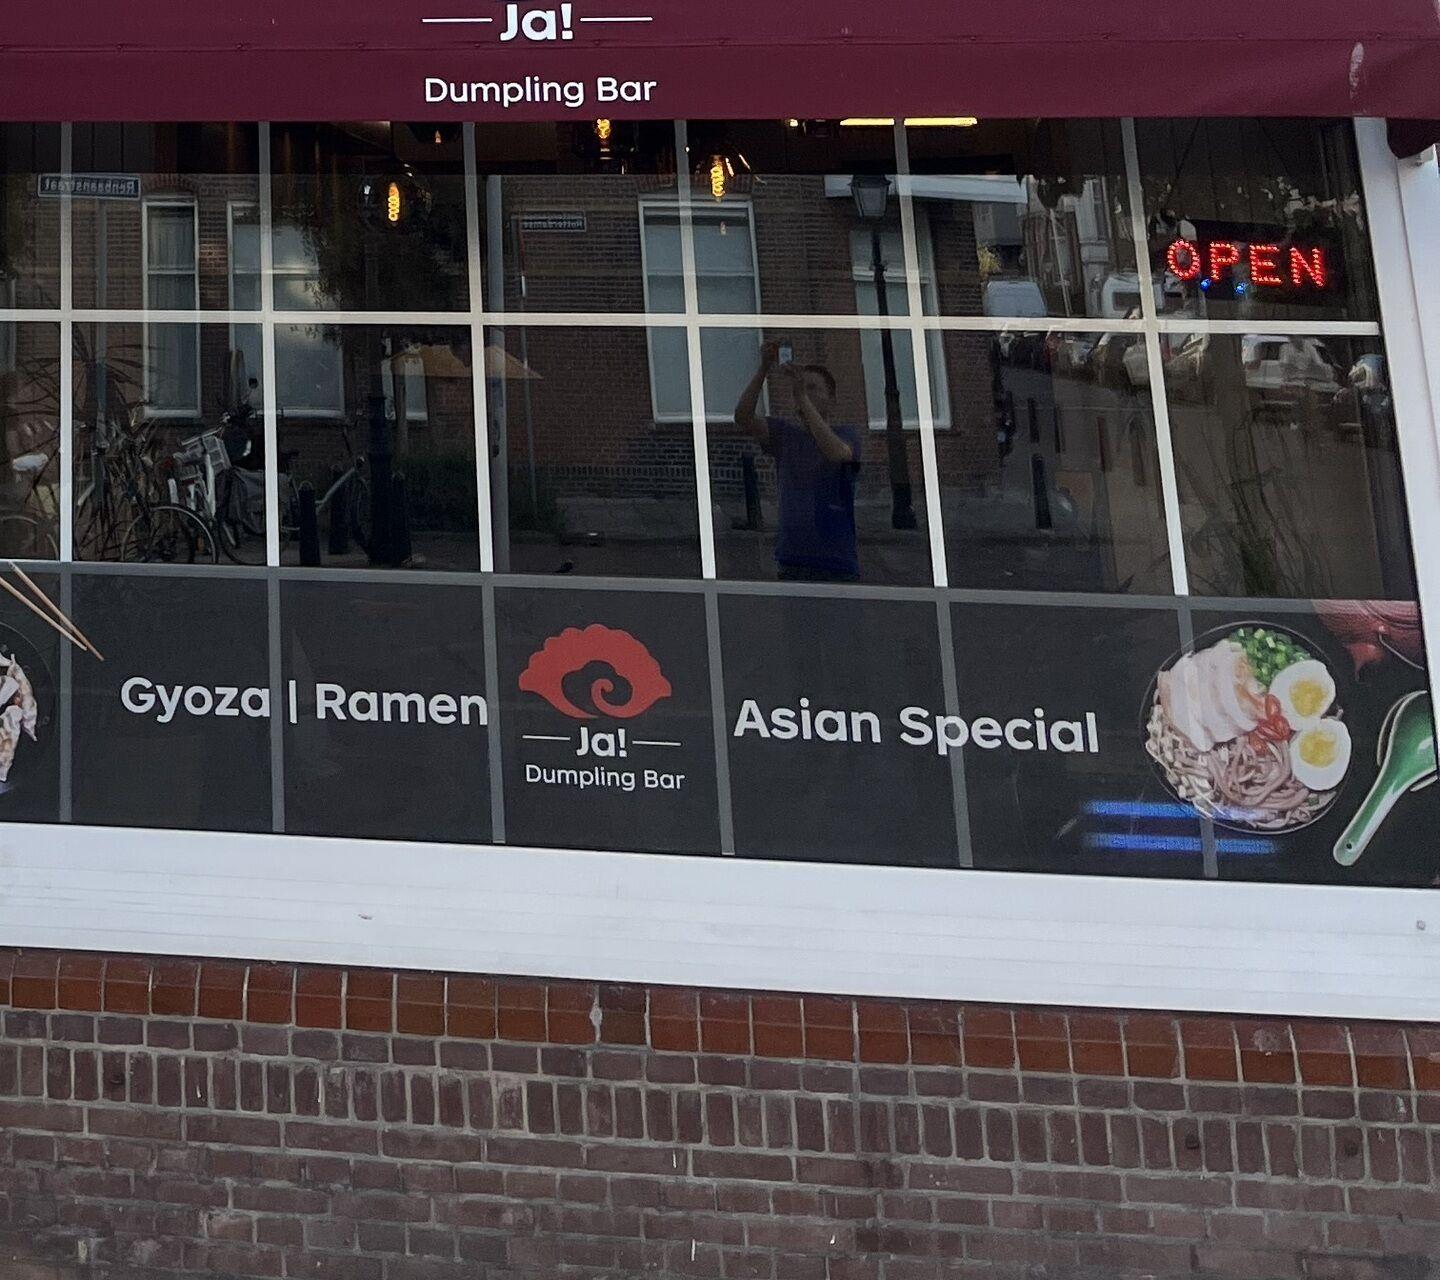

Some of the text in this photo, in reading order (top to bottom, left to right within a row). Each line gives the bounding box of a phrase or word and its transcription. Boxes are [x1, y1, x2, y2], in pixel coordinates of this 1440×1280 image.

[500, 3, 573, 41] Ja!
[424, 76, 657, 108] Dumpling Bar
[1167, 239, 1327, 288] OPEN
[120, 676, 271, 724] Gyoza
[316, 682, 488, 727] Ramen
[576, 726, 627, 758] Ja!
[734, 698, 1099, 755] Asian Special
[525, 764, 685, 791] Dumpling Bar
